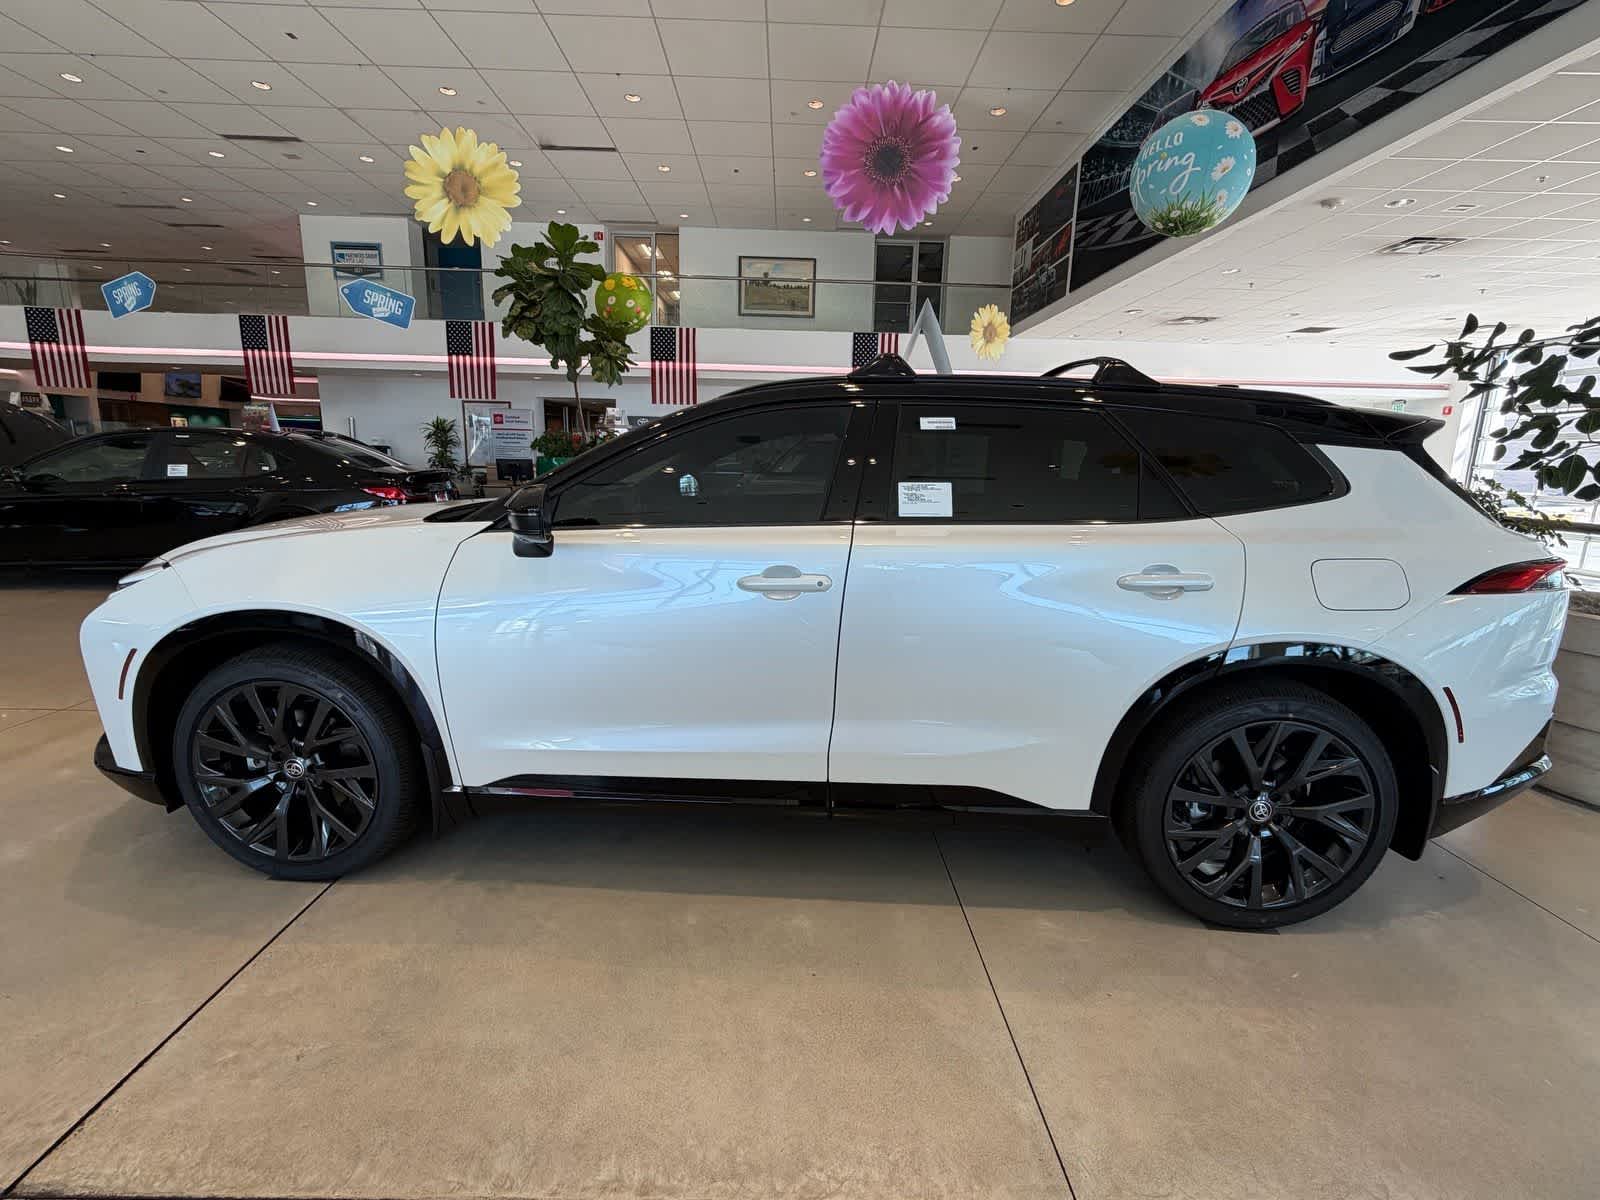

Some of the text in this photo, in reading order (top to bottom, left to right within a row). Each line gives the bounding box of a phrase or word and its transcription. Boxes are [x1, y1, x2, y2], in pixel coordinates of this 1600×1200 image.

[1141, 131, 1184, 162] HELLO
[112, 281, 142, 305] SPRING
[363, 289, 404, 316] SPRING
